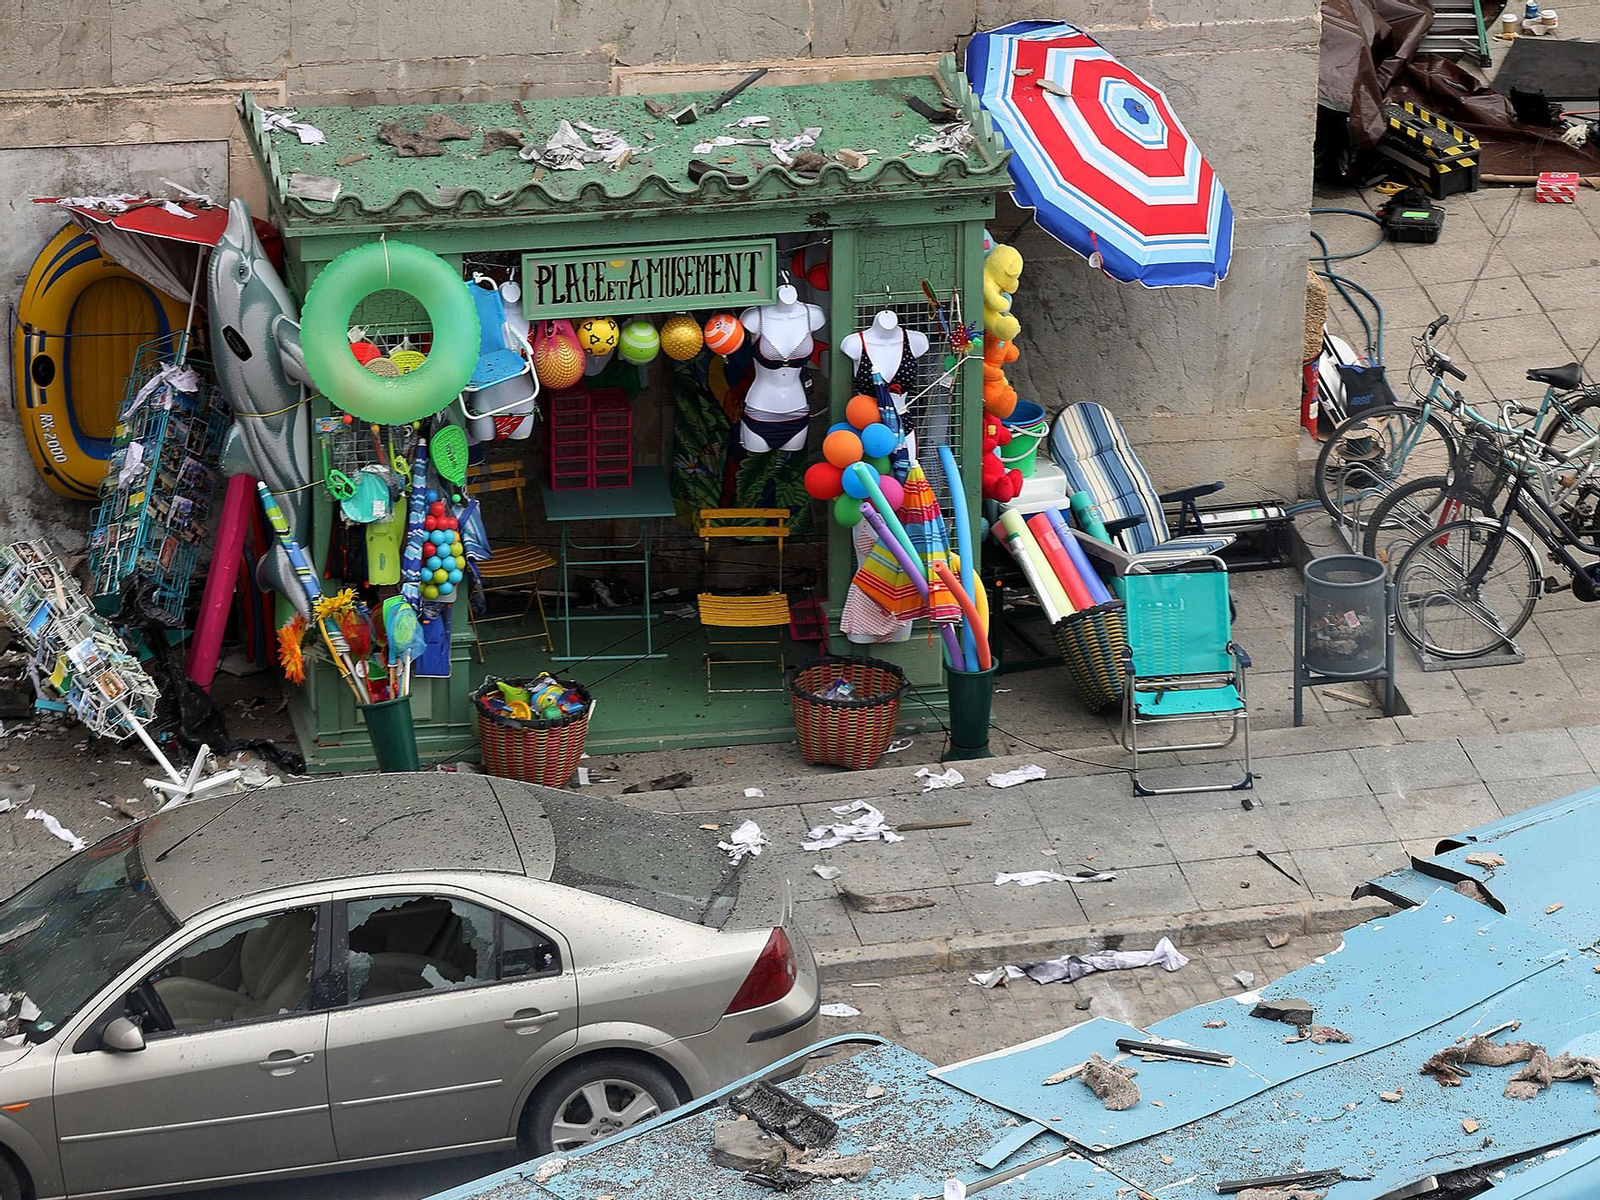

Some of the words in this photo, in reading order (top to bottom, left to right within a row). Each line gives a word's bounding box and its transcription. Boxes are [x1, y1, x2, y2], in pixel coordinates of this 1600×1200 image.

[534, 261, 607, 305] PLAGE
[628, 251, 763, 300] AMUSEMENT
[40, 413, 68, 463] RX-2000
